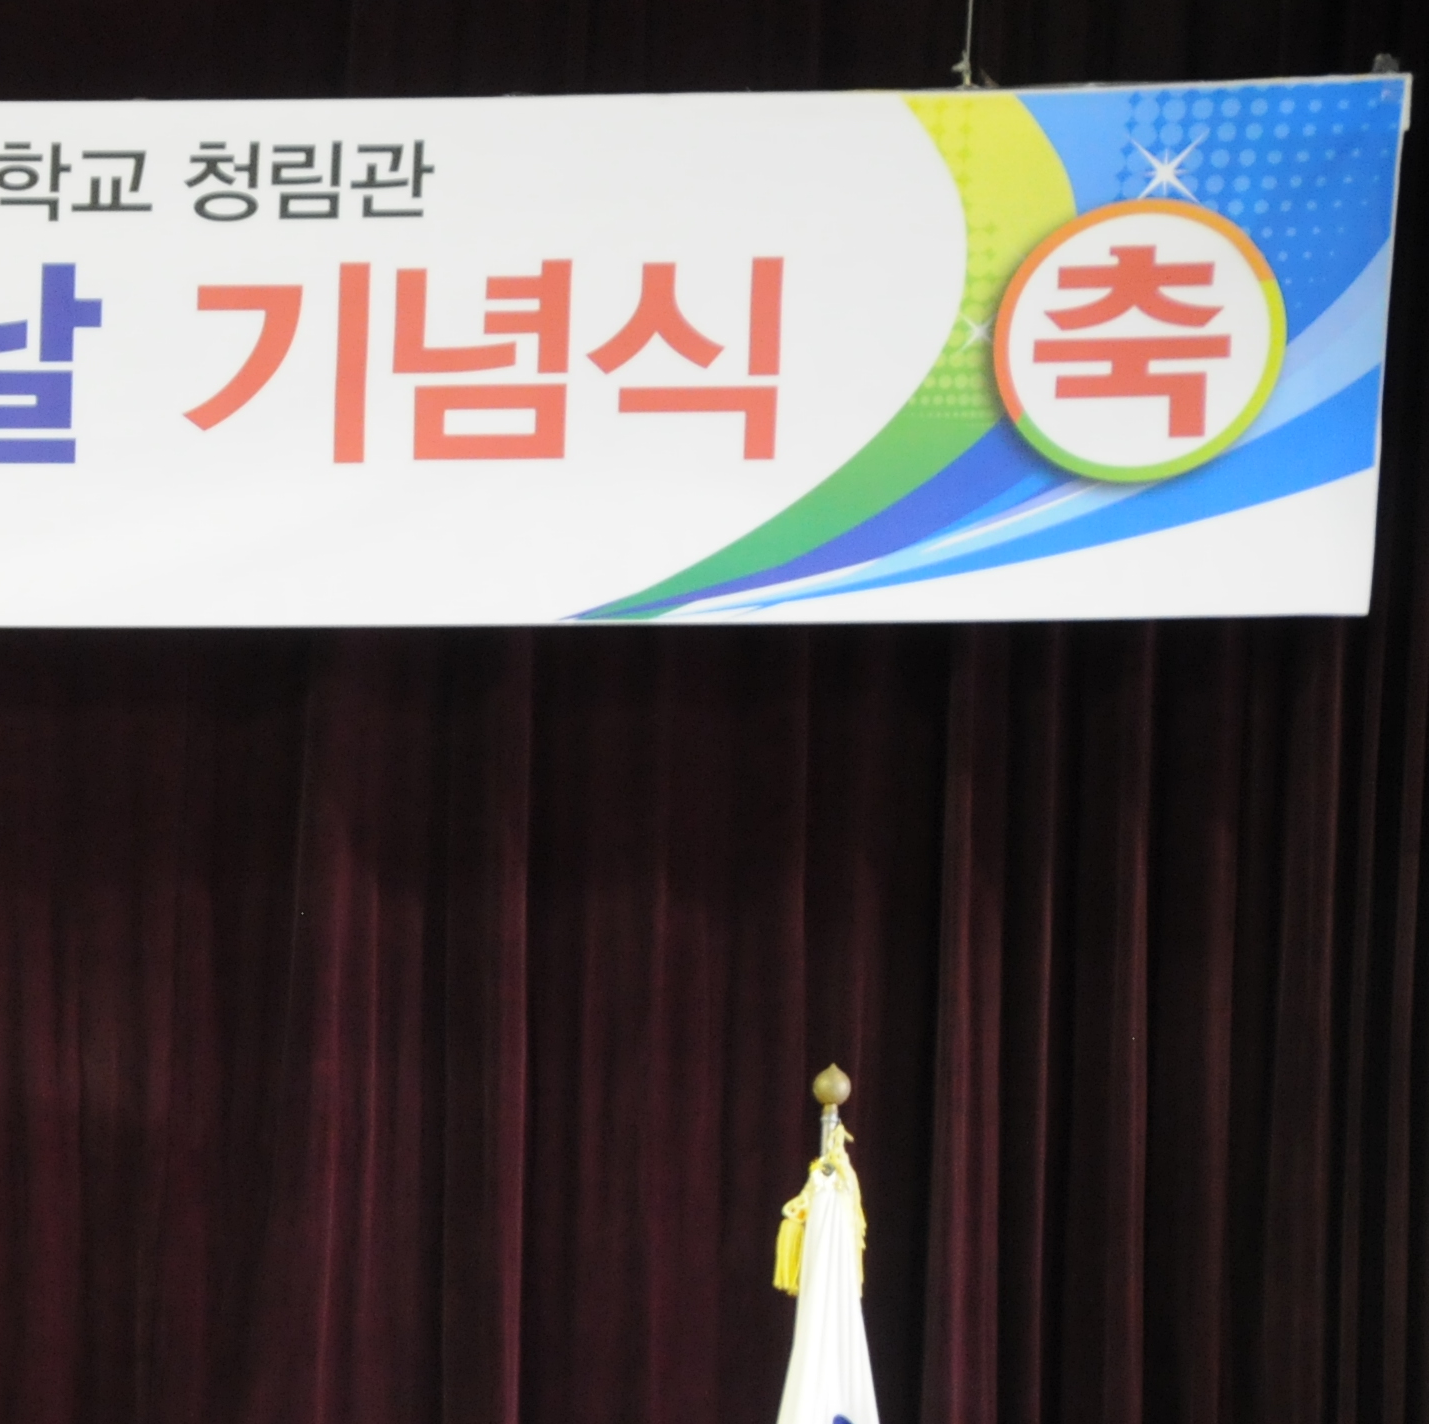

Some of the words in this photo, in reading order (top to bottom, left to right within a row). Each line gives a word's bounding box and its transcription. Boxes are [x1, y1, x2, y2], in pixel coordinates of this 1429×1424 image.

[185, 141, 434, 221] 청림관
[184, 257, 784, 463] 기념식
[1031, 243, 1233, 440] 축
